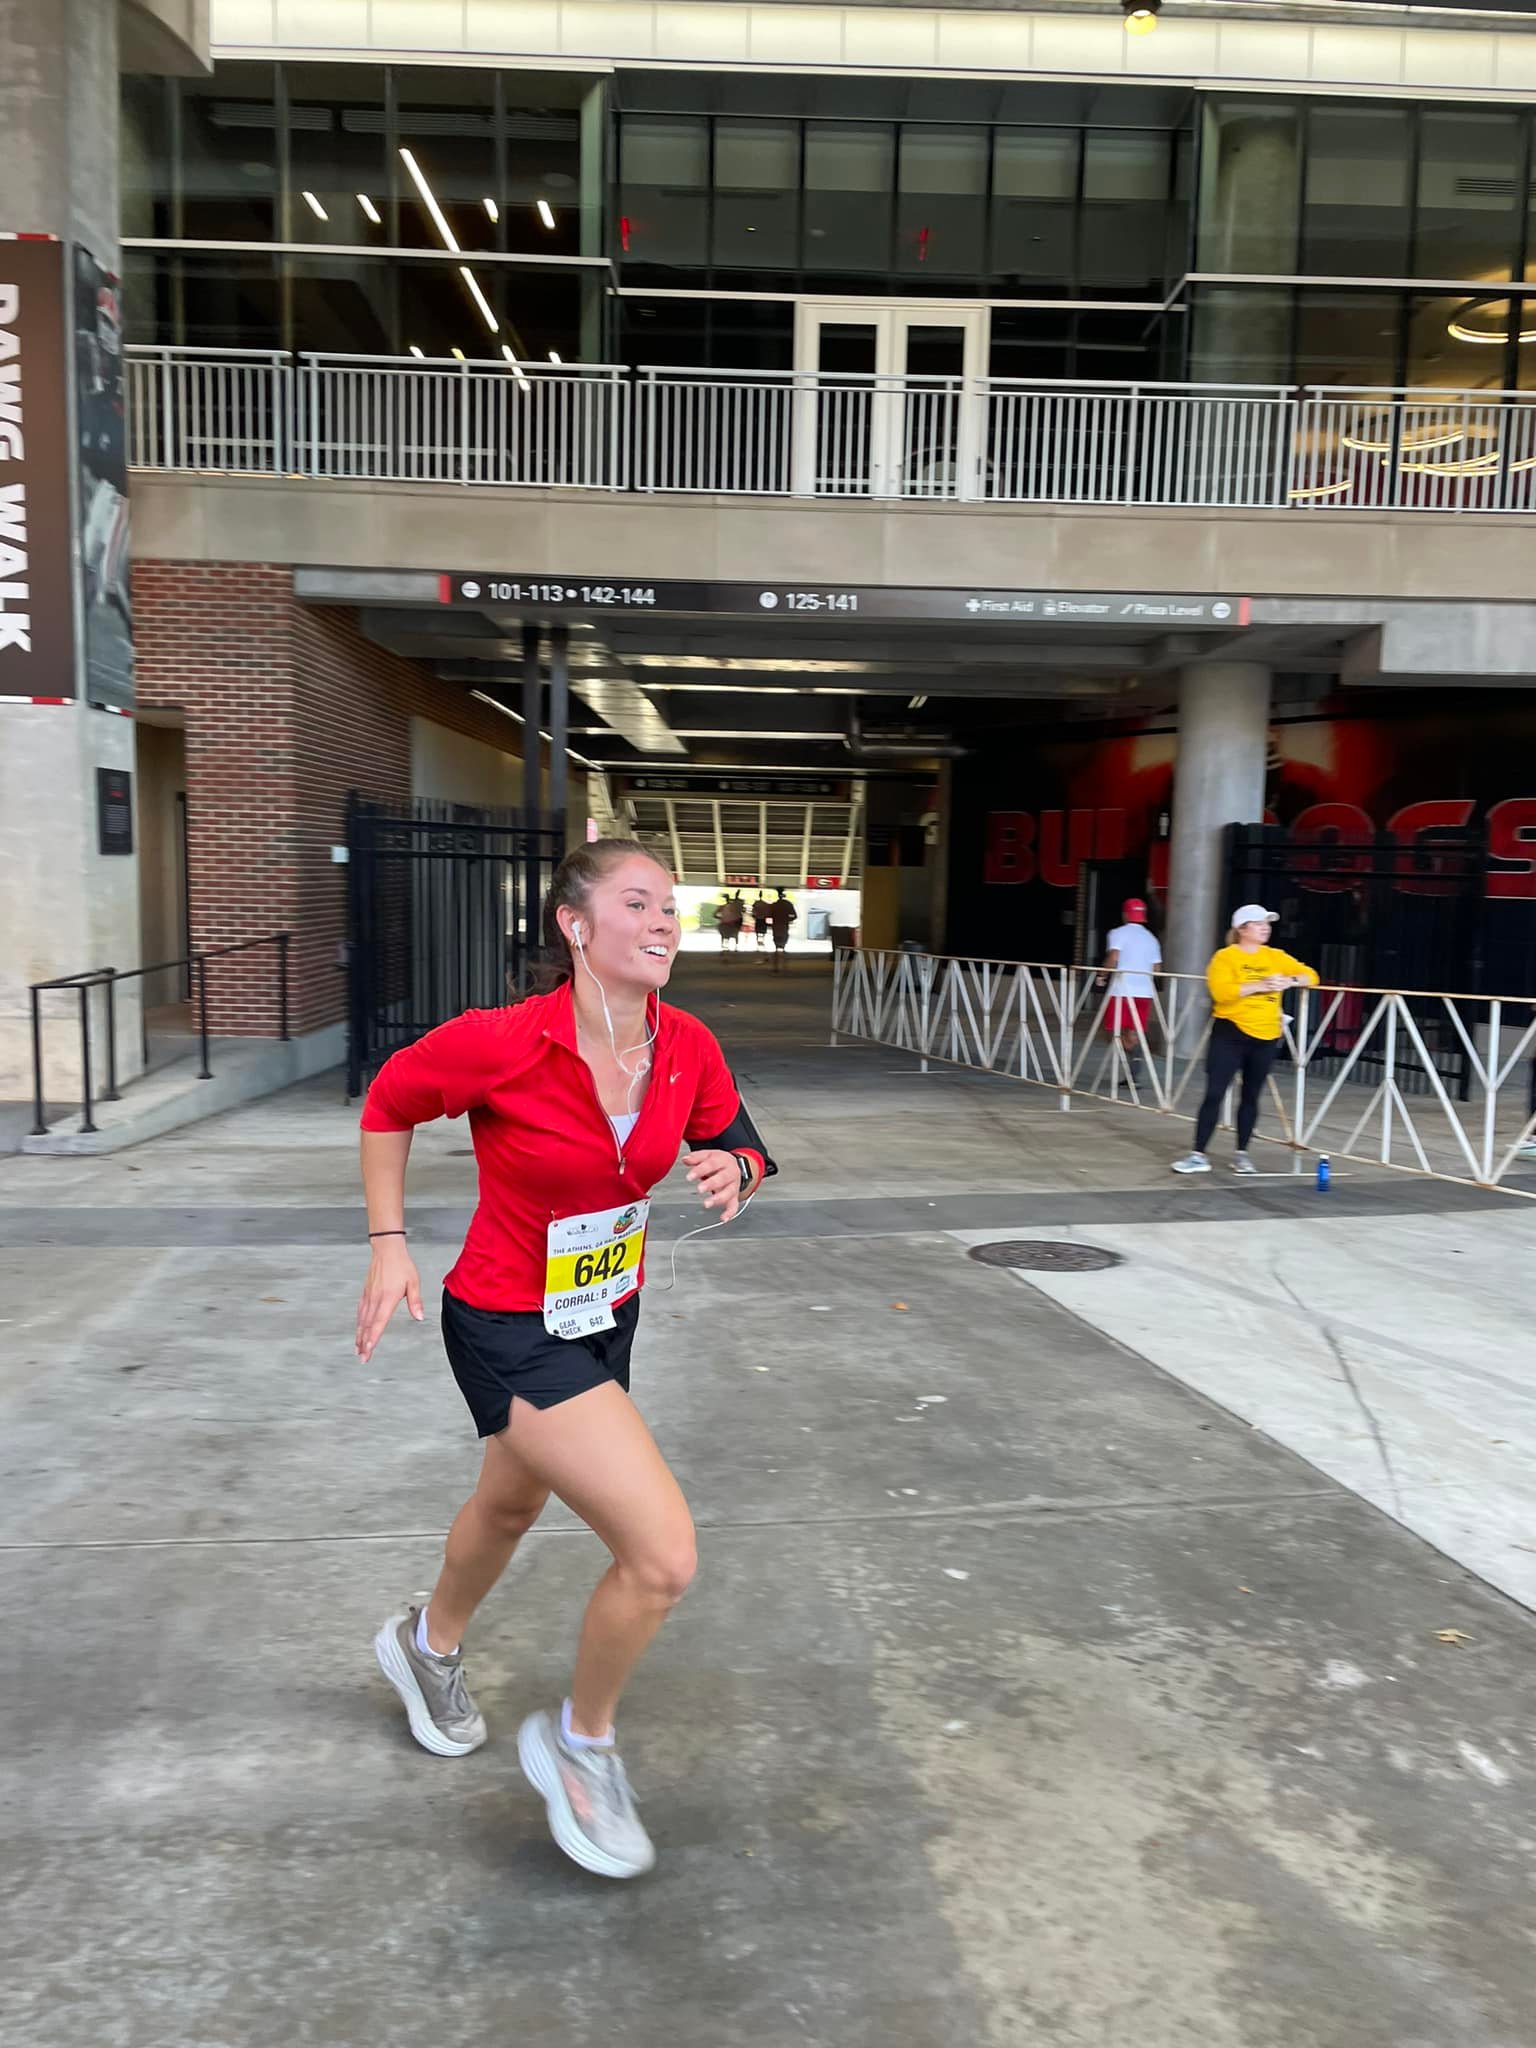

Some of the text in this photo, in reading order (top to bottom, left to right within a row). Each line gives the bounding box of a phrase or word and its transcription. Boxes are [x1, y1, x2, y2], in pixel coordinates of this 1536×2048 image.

[0, 483, 32, 652] WALK
[488, 583, 656, 604] 101-113 142-144
[785, 593, 858, 611] 125-141
[983, 797, 1536, 900] BUOGS
[574, 1242, 627, 1288] 642
[555, 1288, 608, 1310] CORRAL: B
[559, 1319, 577, 1330] GEAR
[561, 1326, 582, 1337] CHECK
[589, 1315, 605, 1328] 642
